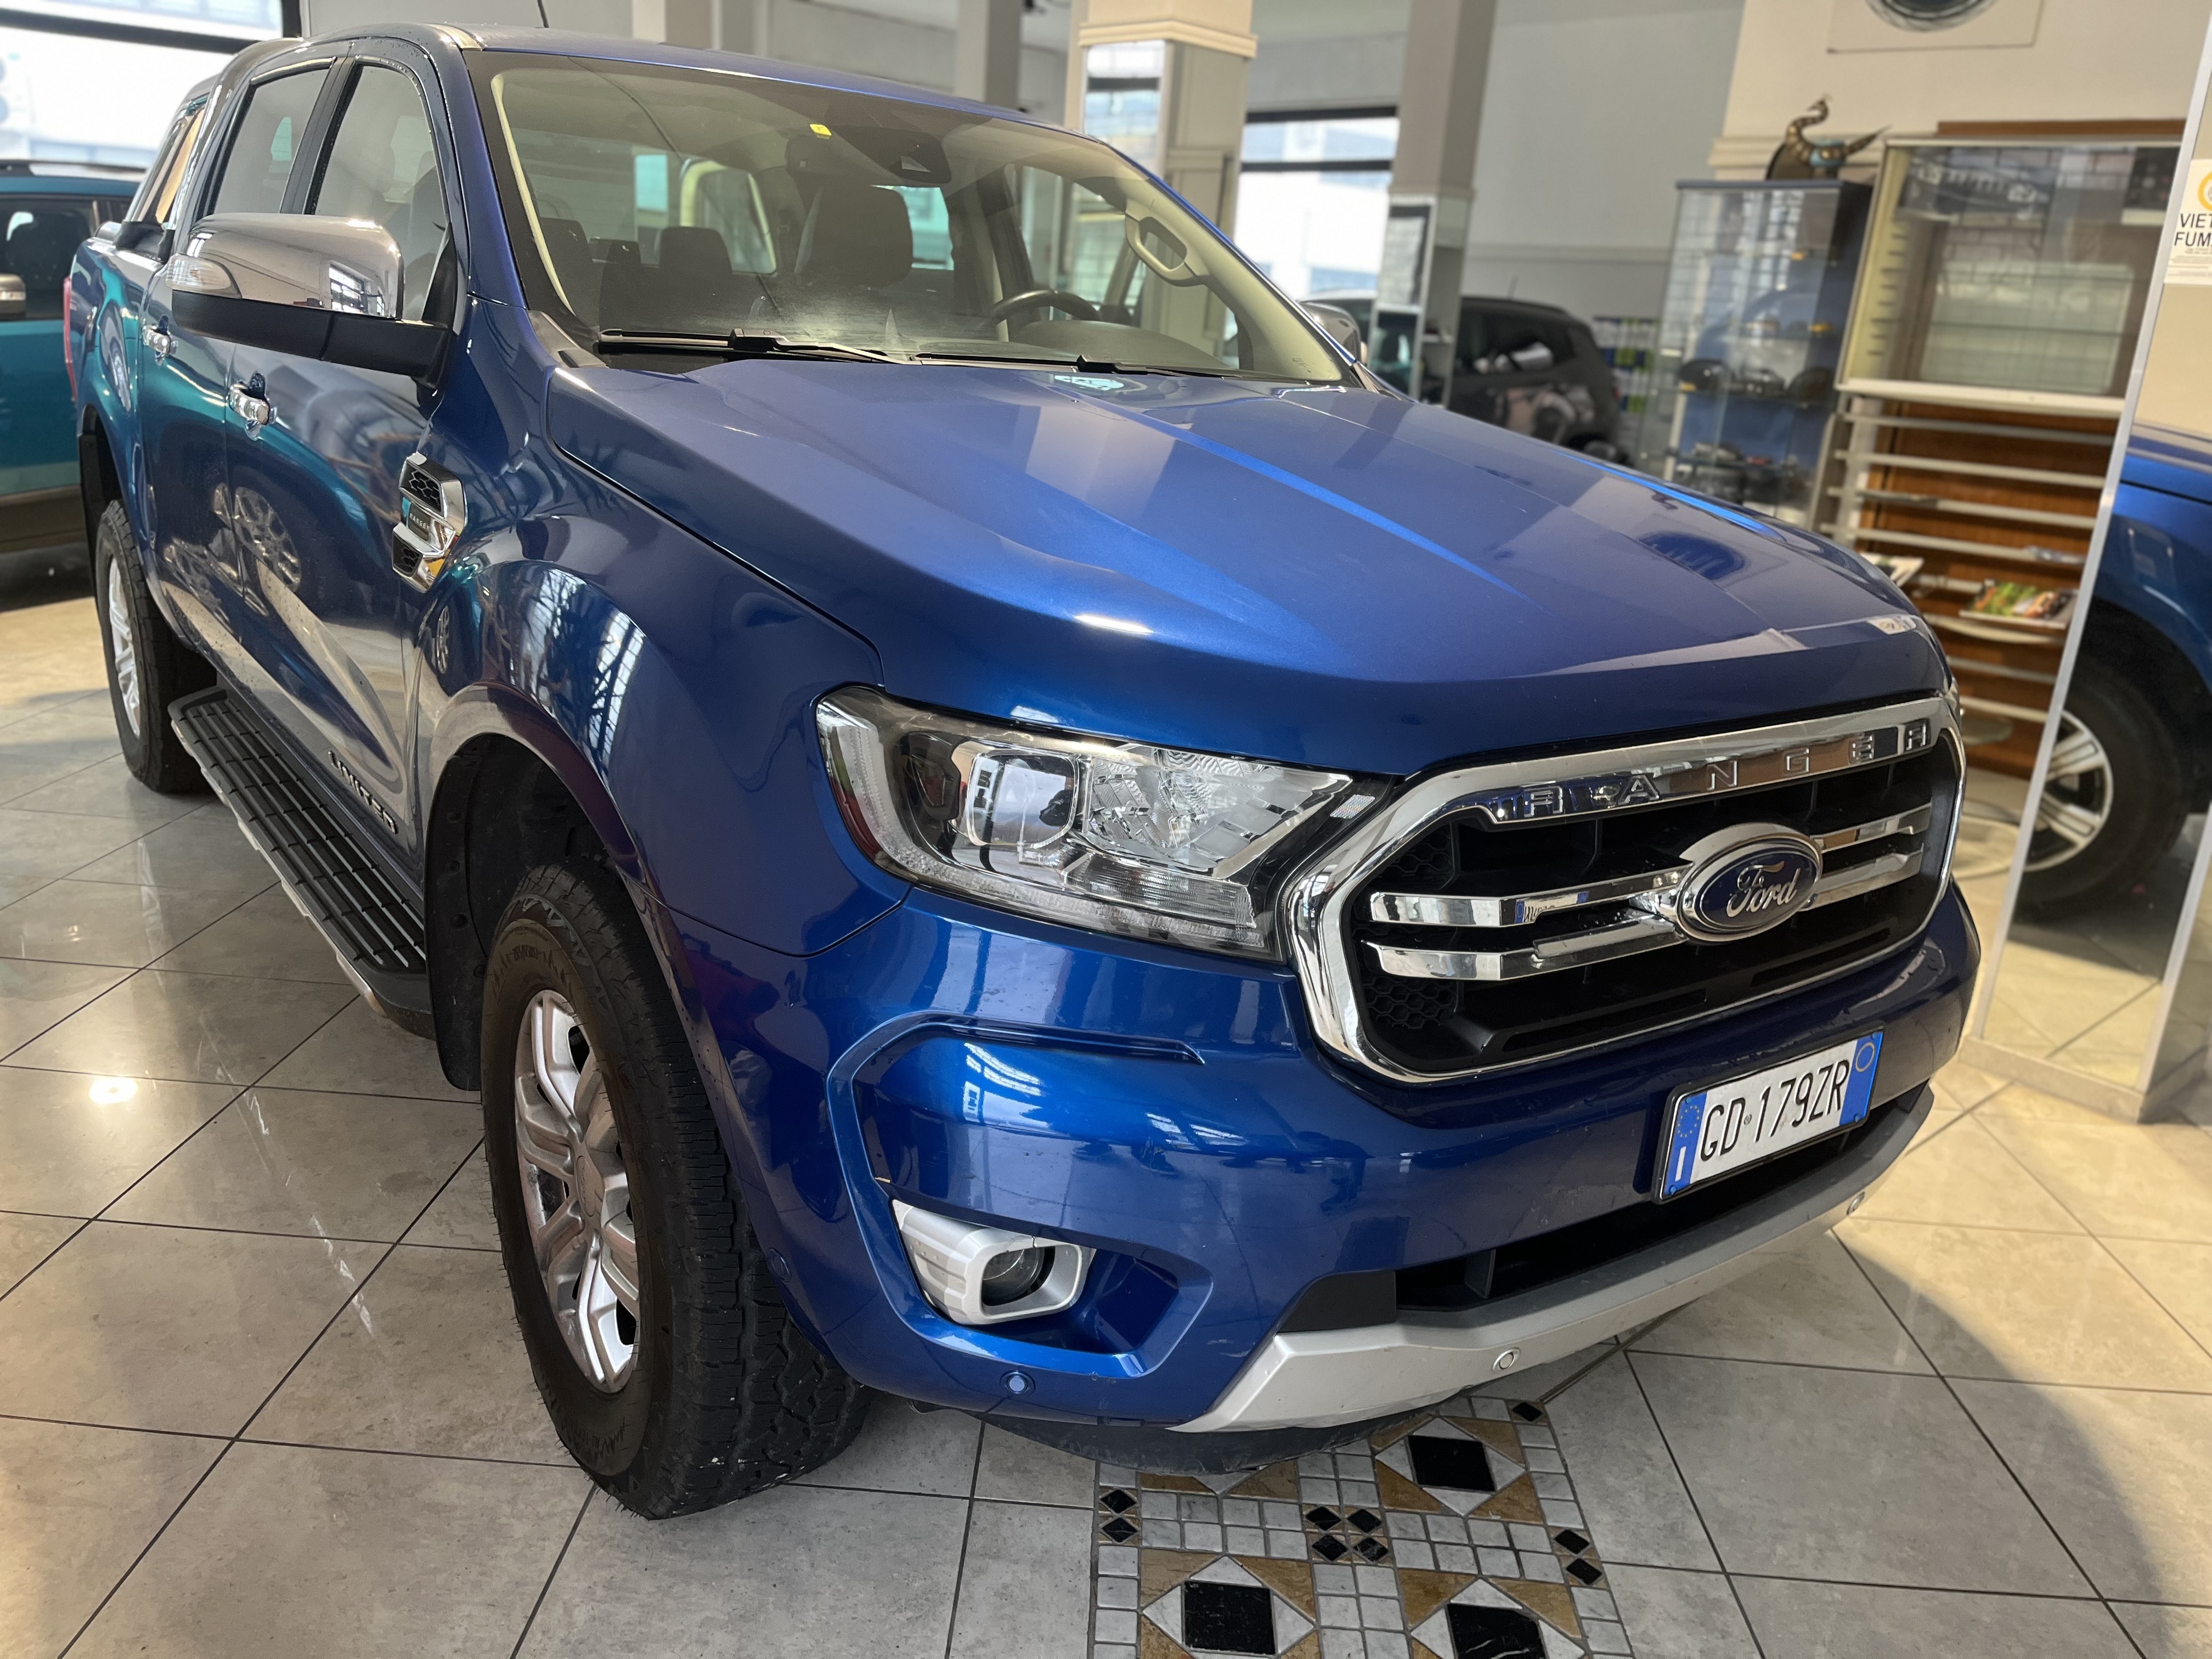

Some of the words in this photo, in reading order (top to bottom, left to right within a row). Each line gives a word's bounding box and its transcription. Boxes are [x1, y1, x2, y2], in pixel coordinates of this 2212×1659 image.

[2174, 232, 2212, 247] FUM
[1523, 718, 1930, 819] RANGER
[1726, 860, 1801, 918] Ford
[1675, 1146, 1686, 1182] I
